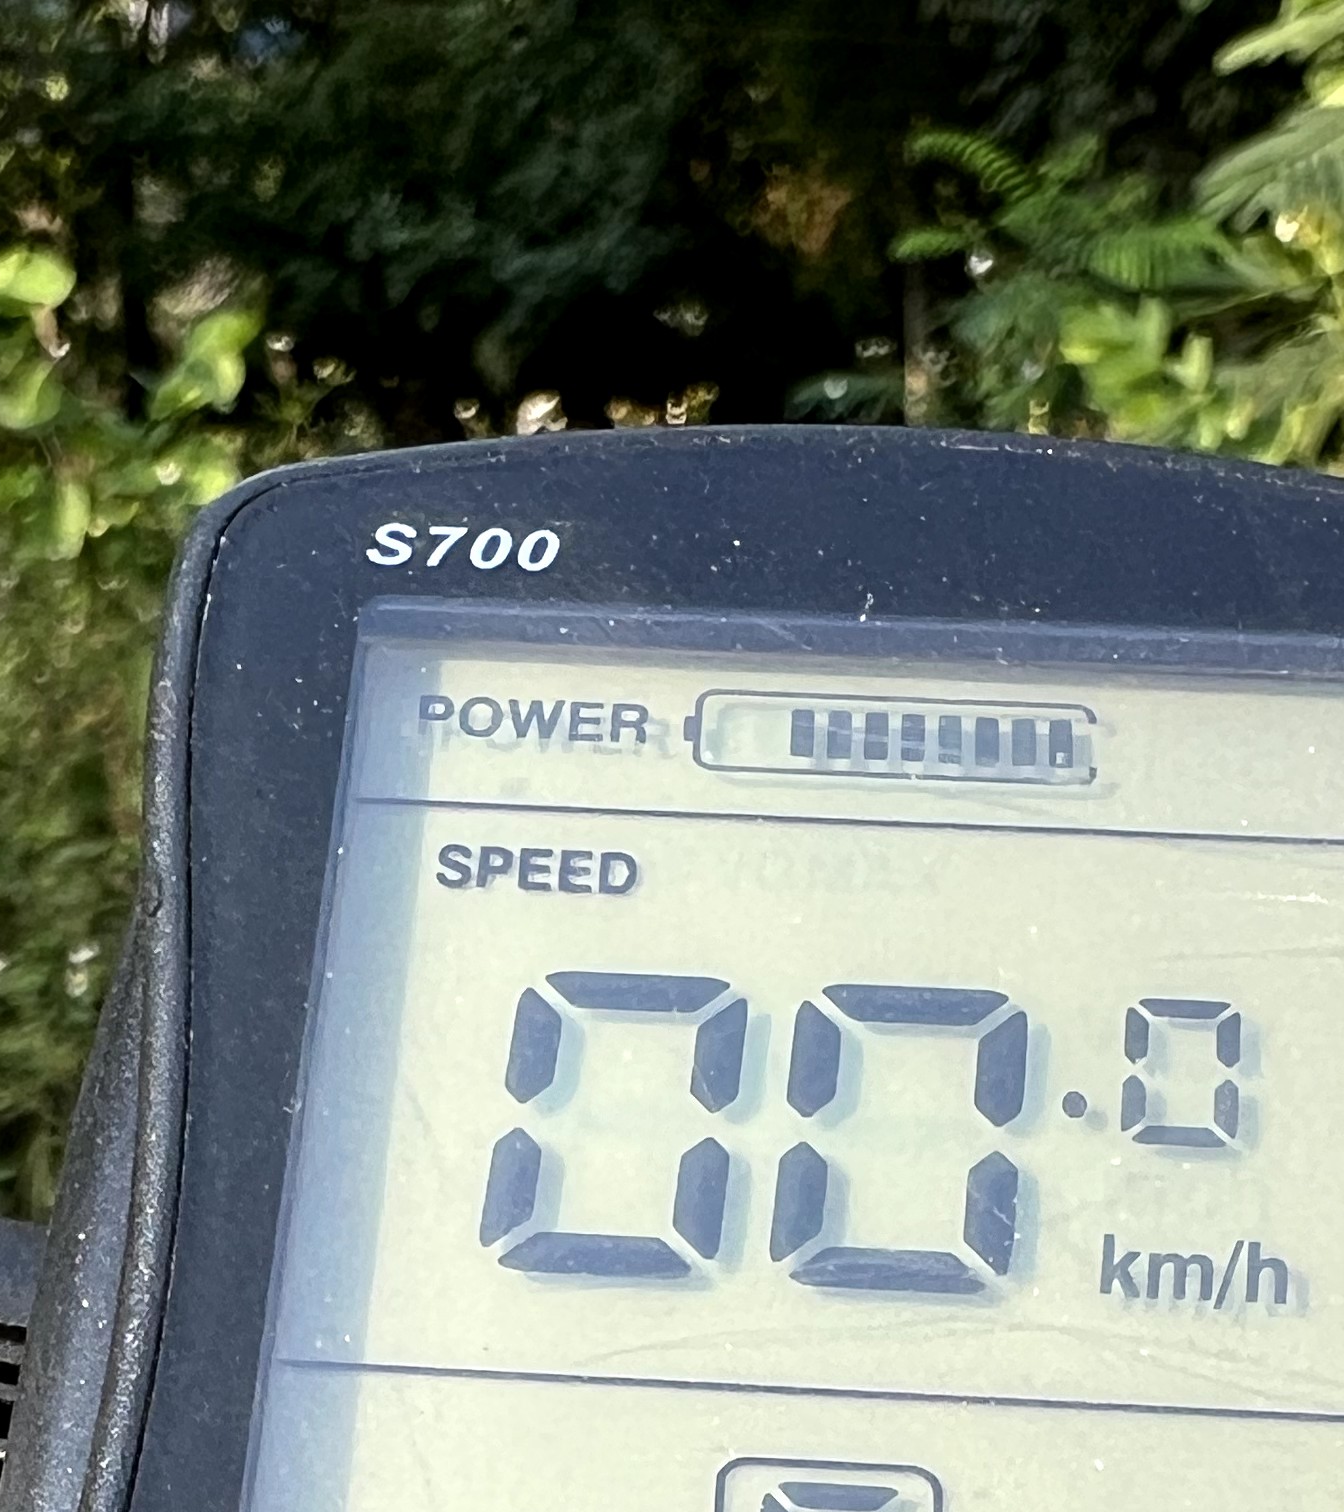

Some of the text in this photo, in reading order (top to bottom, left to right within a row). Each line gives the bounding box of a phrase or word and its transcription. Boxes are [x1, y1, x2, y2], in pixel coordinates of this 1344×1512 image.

[365, 521, 562, 573] S700
[418, 693, 650, 746] POWER
[435, 843, 639, 897] SPEED
[1099, 1233, 1290, 1310] km/h
